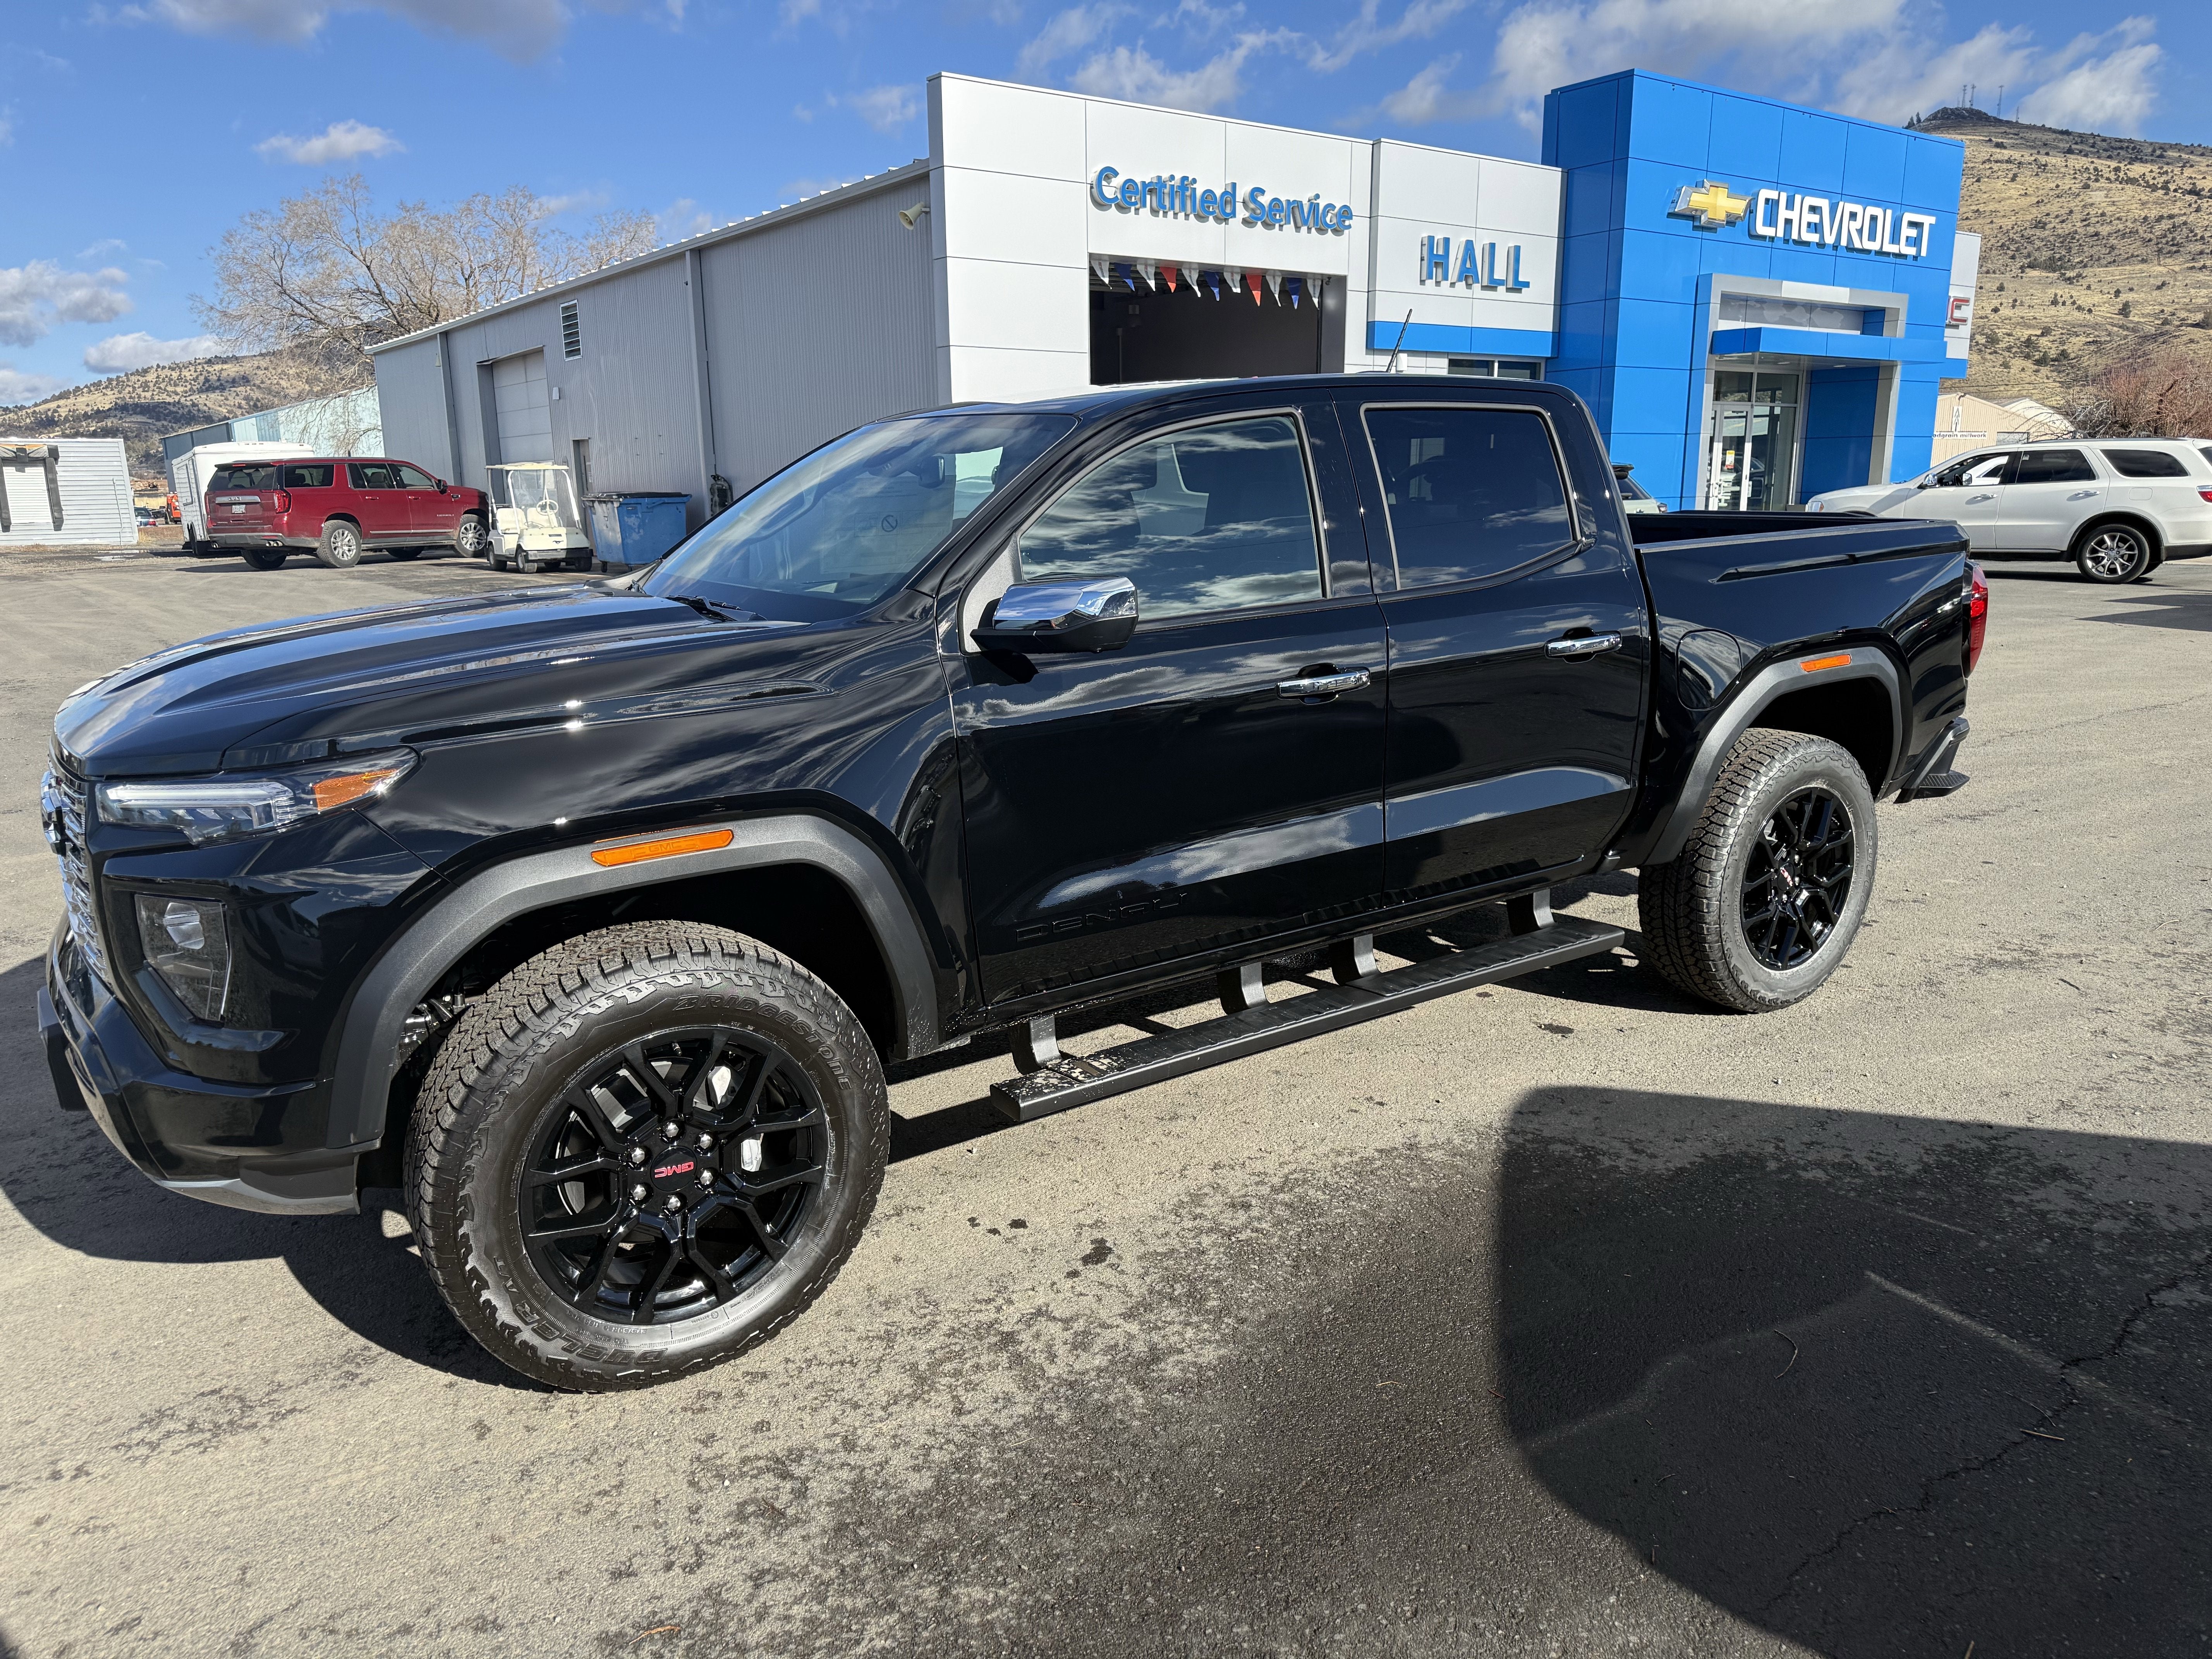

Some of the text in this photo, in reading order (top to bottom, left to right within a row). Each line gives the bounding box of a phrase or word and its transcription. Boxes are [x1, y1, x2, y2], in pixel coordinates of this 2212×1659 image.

[1095, 166, 1353, 230] Certified Service
[1755, 188, 1936, 257] CHEVROLET
[1425, 235, 1530, 289] HALL
[1016, 893, 1187, 942] DENALI
[672, 993, 854, 1091] BRIDGESTONE
[654, 1161, 694, 1178] GMC
[517, 1300, 668, 1367] DUELER
